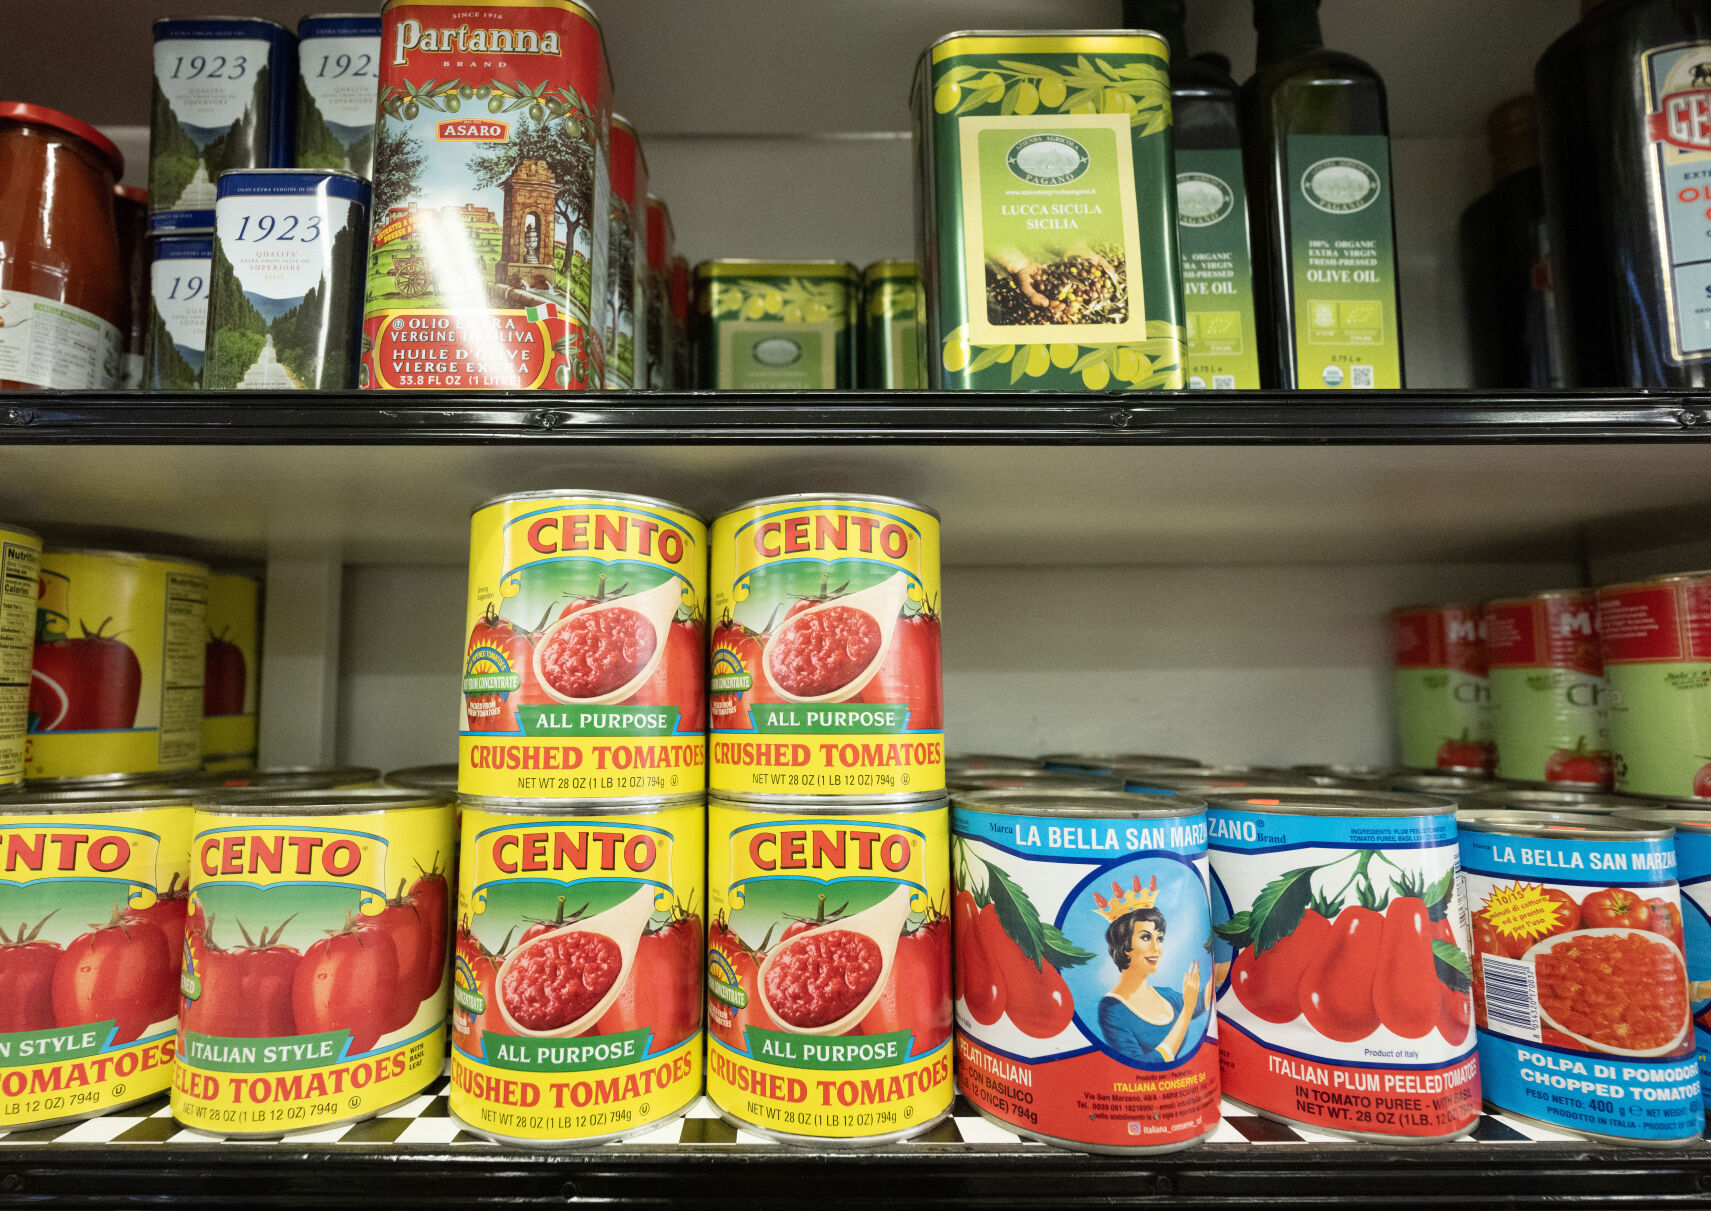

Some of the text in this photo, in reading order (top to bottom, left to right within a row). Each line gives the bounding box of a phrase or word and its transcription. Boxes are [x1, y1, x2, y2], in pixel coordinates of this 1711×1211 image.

[393, 19, 562, 66] Partanna
[170, 56, 247, 80] 1923
[316, 54, 379, 78] 192
[444, 126, 501, 136] ASARO
[1026, 174, 1074, 184] PAGANO
[1002, 204, 1102, 216] LUCCA SICULA
[234, 215, 321, 242] 1923
[1026, 218, 1078, 230] SICILIA
[1309, 240, 1375, 248] 100% ORGANIC
[1344, 249, 1376, 257] VIRGIN
[1309, 258, 1378, 266] FRESH-PRESSED
[1212, 282, 1238, 294] OIL
[1307, 270, 1380, 282] OLIVE OIL
[409, 318, 450, 329] OLIO
[391, 332, 456, 342] VERGINE
[392, 350, 449, 360] HUILE
[392, 362, 529, 374] VIERGE EXTRA
[400, 376, 520, 386] 33.8 FL OZ (1 LITRE)
[528, 514, 684, 564] CENTO
[754, 515, 908, 559] CENTO
[536, 714, 668, 728] ALL PURPOSE
[768, 712, 896, 726] ALL PURPOSE
[470, 744, 704, 770] CRUSHED TOMATOES
[714, 742, 940, 767] CRUSHED TOMATOES
[518, 777, 665, 790] NET WT 28 OZ (1 LB 12 OZ) 794g
[753, 773, 895, 786] NET WT 28 OZ (1 LB 12 OZ) 794g
[990, 822, 1013, 834] Marca
[1015, 824, 1041, 846] LA
[1048, 826, 1119, 850] BELLA
[1126, 827, 1164, 850] SAN
[1208, 818, 1286, 844] ZANO Brand
[0, 833, 131, 872] NTO
[200, 836, 361, 876] CENTO
[492, 832, 657, 874] CENTO
[749, 830, 910, 872] CENTO
[1492, 846, 1516, 864] LA
[1521, 848, 1584, 868] BELLA
[1590, 852, 1627, 870] SAN
[1489, 896, 1548, 919] minuti di cottura
[1496, 891, 1524, 905] 10/15
[1512, 925, 1524, 933] per
[20, 1032, 96, 1057] STYLE
[191, 1040, 333, 1064] ITALIAN STYLE
[410, 1043, 424, 1053] WITH
[410, 1051, 424, 1062] BASIL
[497, 1040, 635, 1064] ALL PURPOSE
[762, 1040, 897, 1062] ALL PURPOSE
[1364, 1048, 1419, 1060] Product of Italy
[0, 1040, 176, 1097] OMATOES
[409, 1059, 422, 1070] LEAF
[960, 1039, 1032, 1087] PELATI ITALIANI
[1269, 1055, 1476, 1094] ITALIAN PLUM PEELED TOMATOES
[1517, 1049, 1698, 1082] POLPA DI POMODORO
[172, 1052, 406, 1104] ELED TOMATOES
[451, 1051, 692, 1108] CRUSHED TOMATOES
[710, 1048, 948, 1107] CRUSHED TOMATOES
[969, 1066, 1033, 1104] CON BASILICO
[1114, 1076, 1198, 1092] ITALIANA CONSERVE
[1520, 1068, 1700, 1102] CHOPPED TOMATOES
[5, 1092, 100, 1115] LB 12 OZ) 794g
[981, 1089, 1038, 1124] ONCE) 794g
[1084, 1092, 1095, 1100] Via
[1296, 1085, 1309, 1099] IN
[1314, 1091, 1370, 1108] TOMATO
[1376, 1097, 1422, 1111] PUREE
[1526, 1088, 1625, 1117] PESO NETTO: 400 g
[747, 1101, 897, 1126] NET WT 28 OZ (1 LB 12 OZ) 794g
[1297, 1099, 1323, 1115] NET
[1328, 1105, 1352, 1121] WT.
[1356, 1110, 1372, 1123] 28
[1376, 1112, 1395, 1125] OZ
[1547, 1106, 1595, 1123] PRODOTTO
[1610, 1120, 1636, 1129] ITALIA
